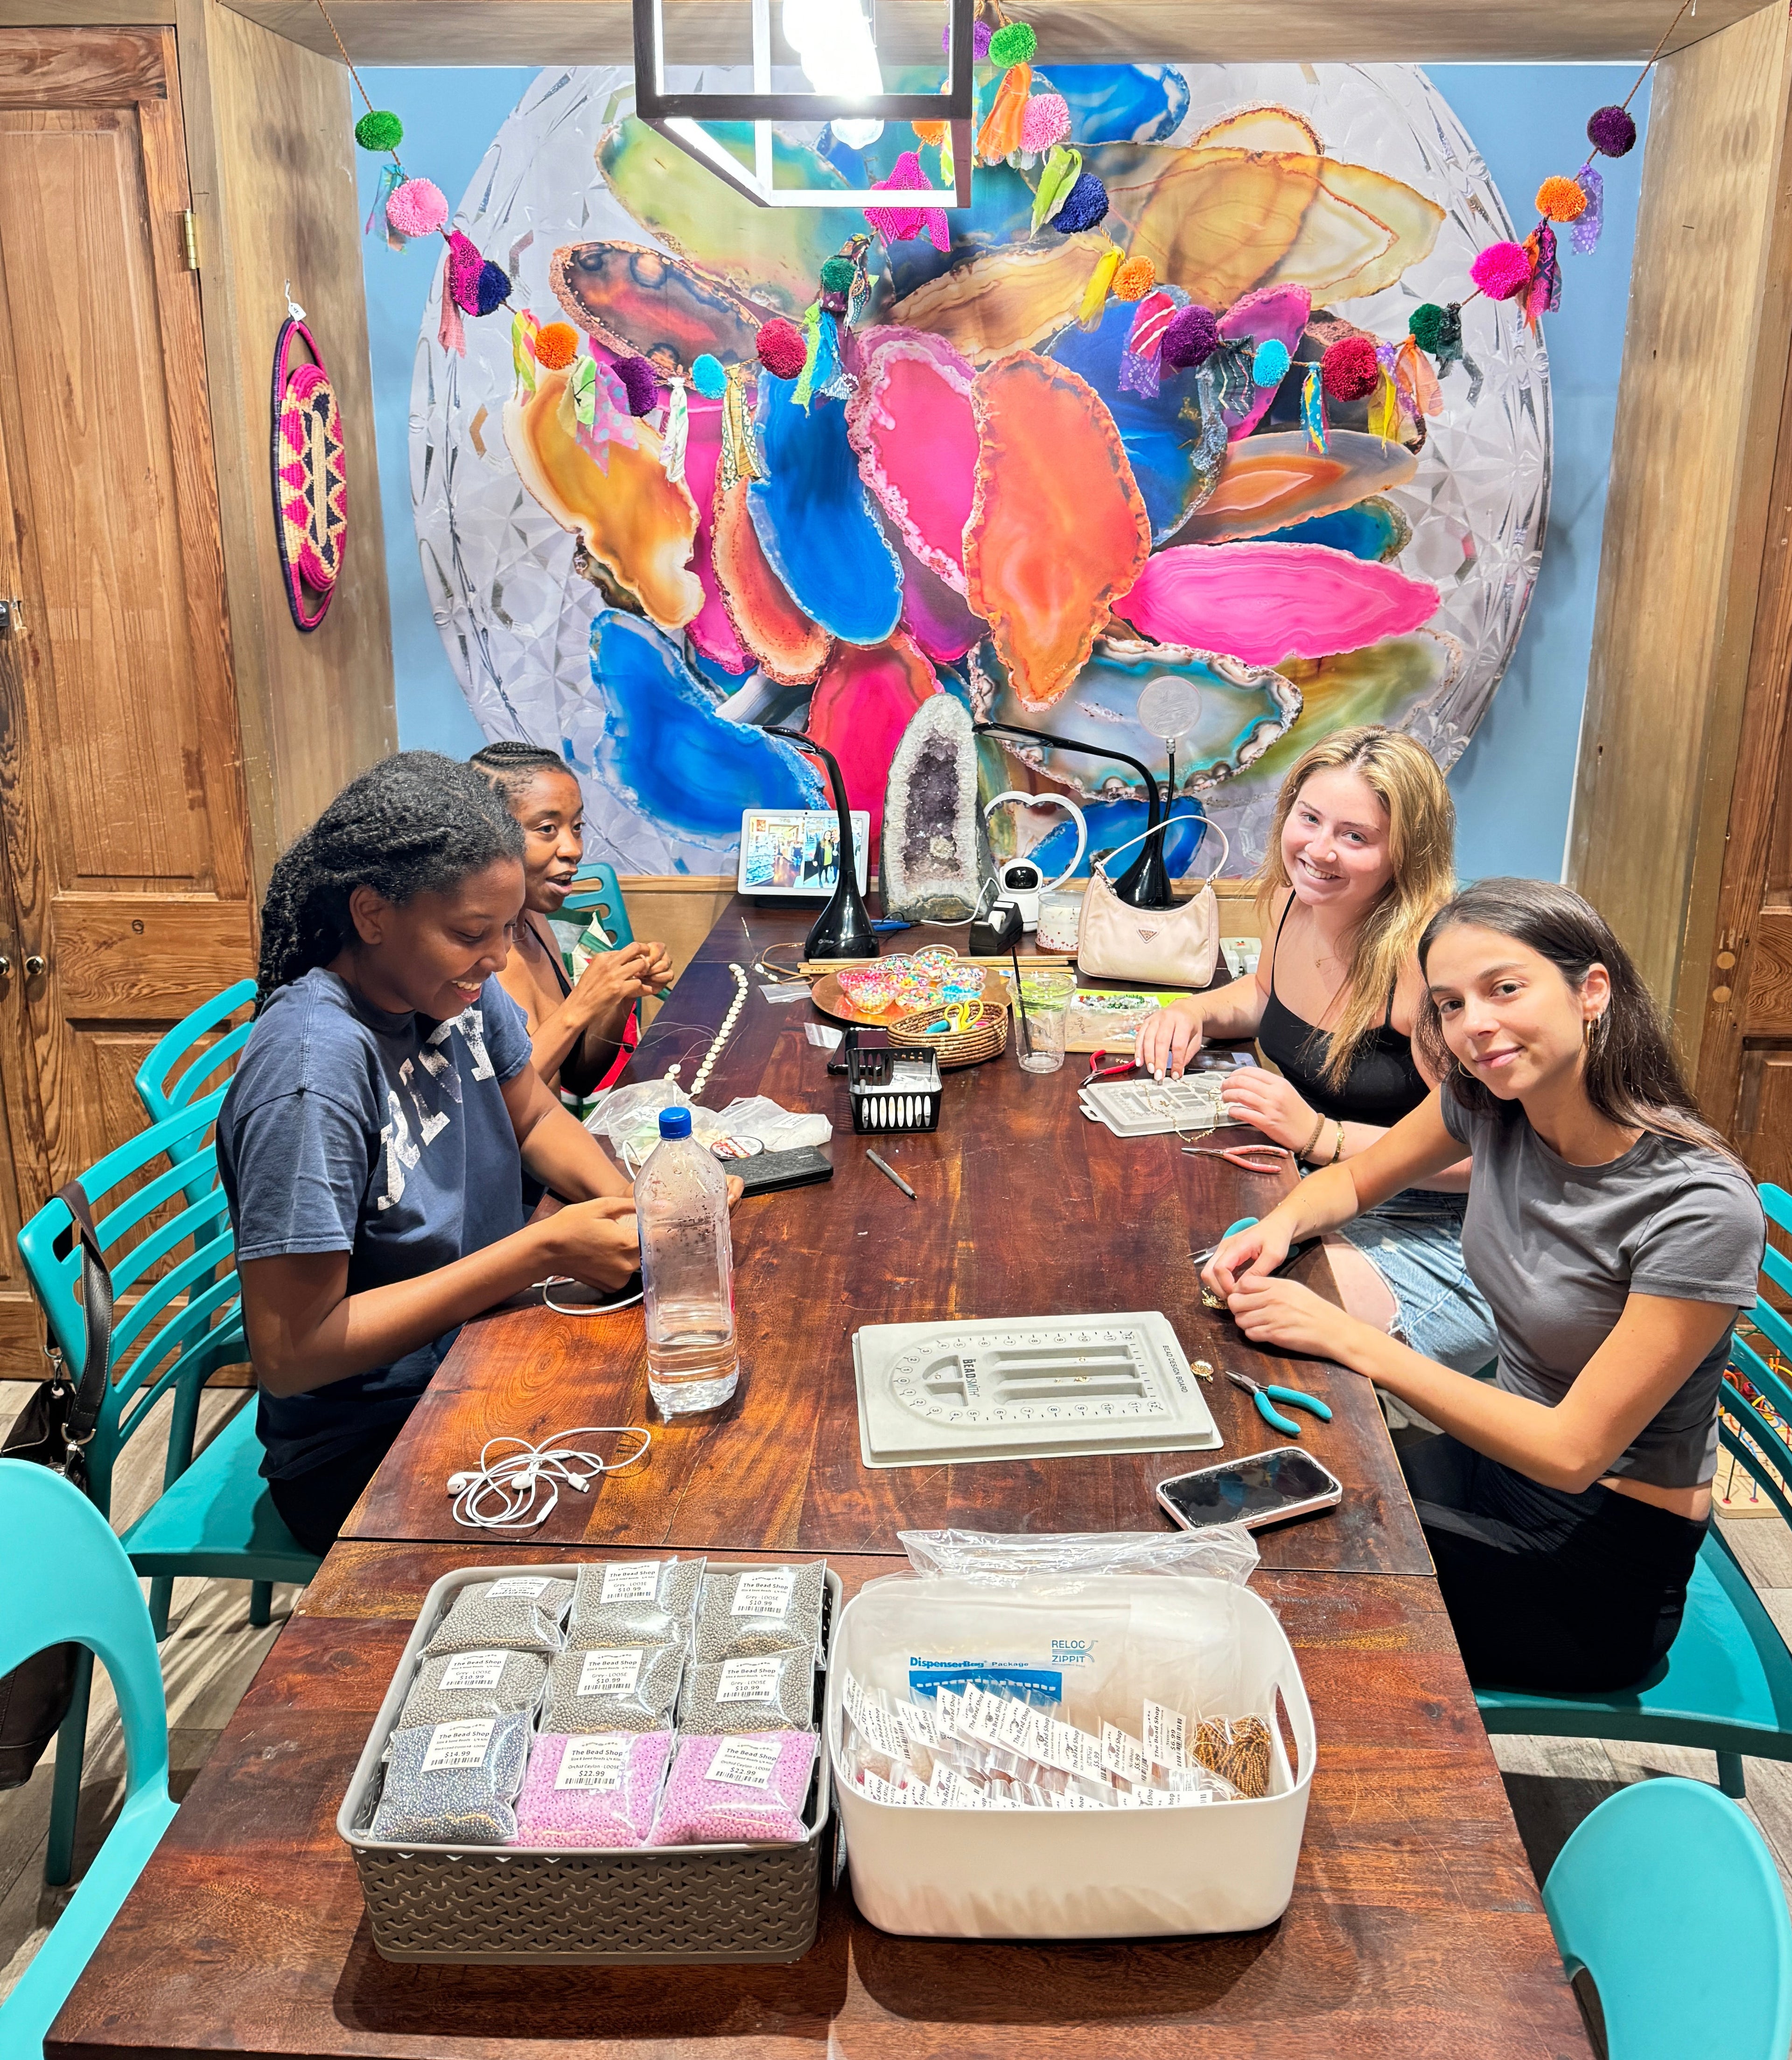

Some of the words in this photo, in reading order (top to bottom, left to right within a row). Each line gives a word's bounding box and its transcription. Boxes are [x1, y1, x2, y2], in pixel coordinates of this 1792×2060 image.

[1163, 1346, 1173, 1357] BEAD
[1169, 1358, 1181, 1375] DESIGN
[1176, 1376, 1188, 1393] BOARD
[1052, 1640, 1085, 1648] RELOC
[730, 1767, 756, 1776] $22.99
